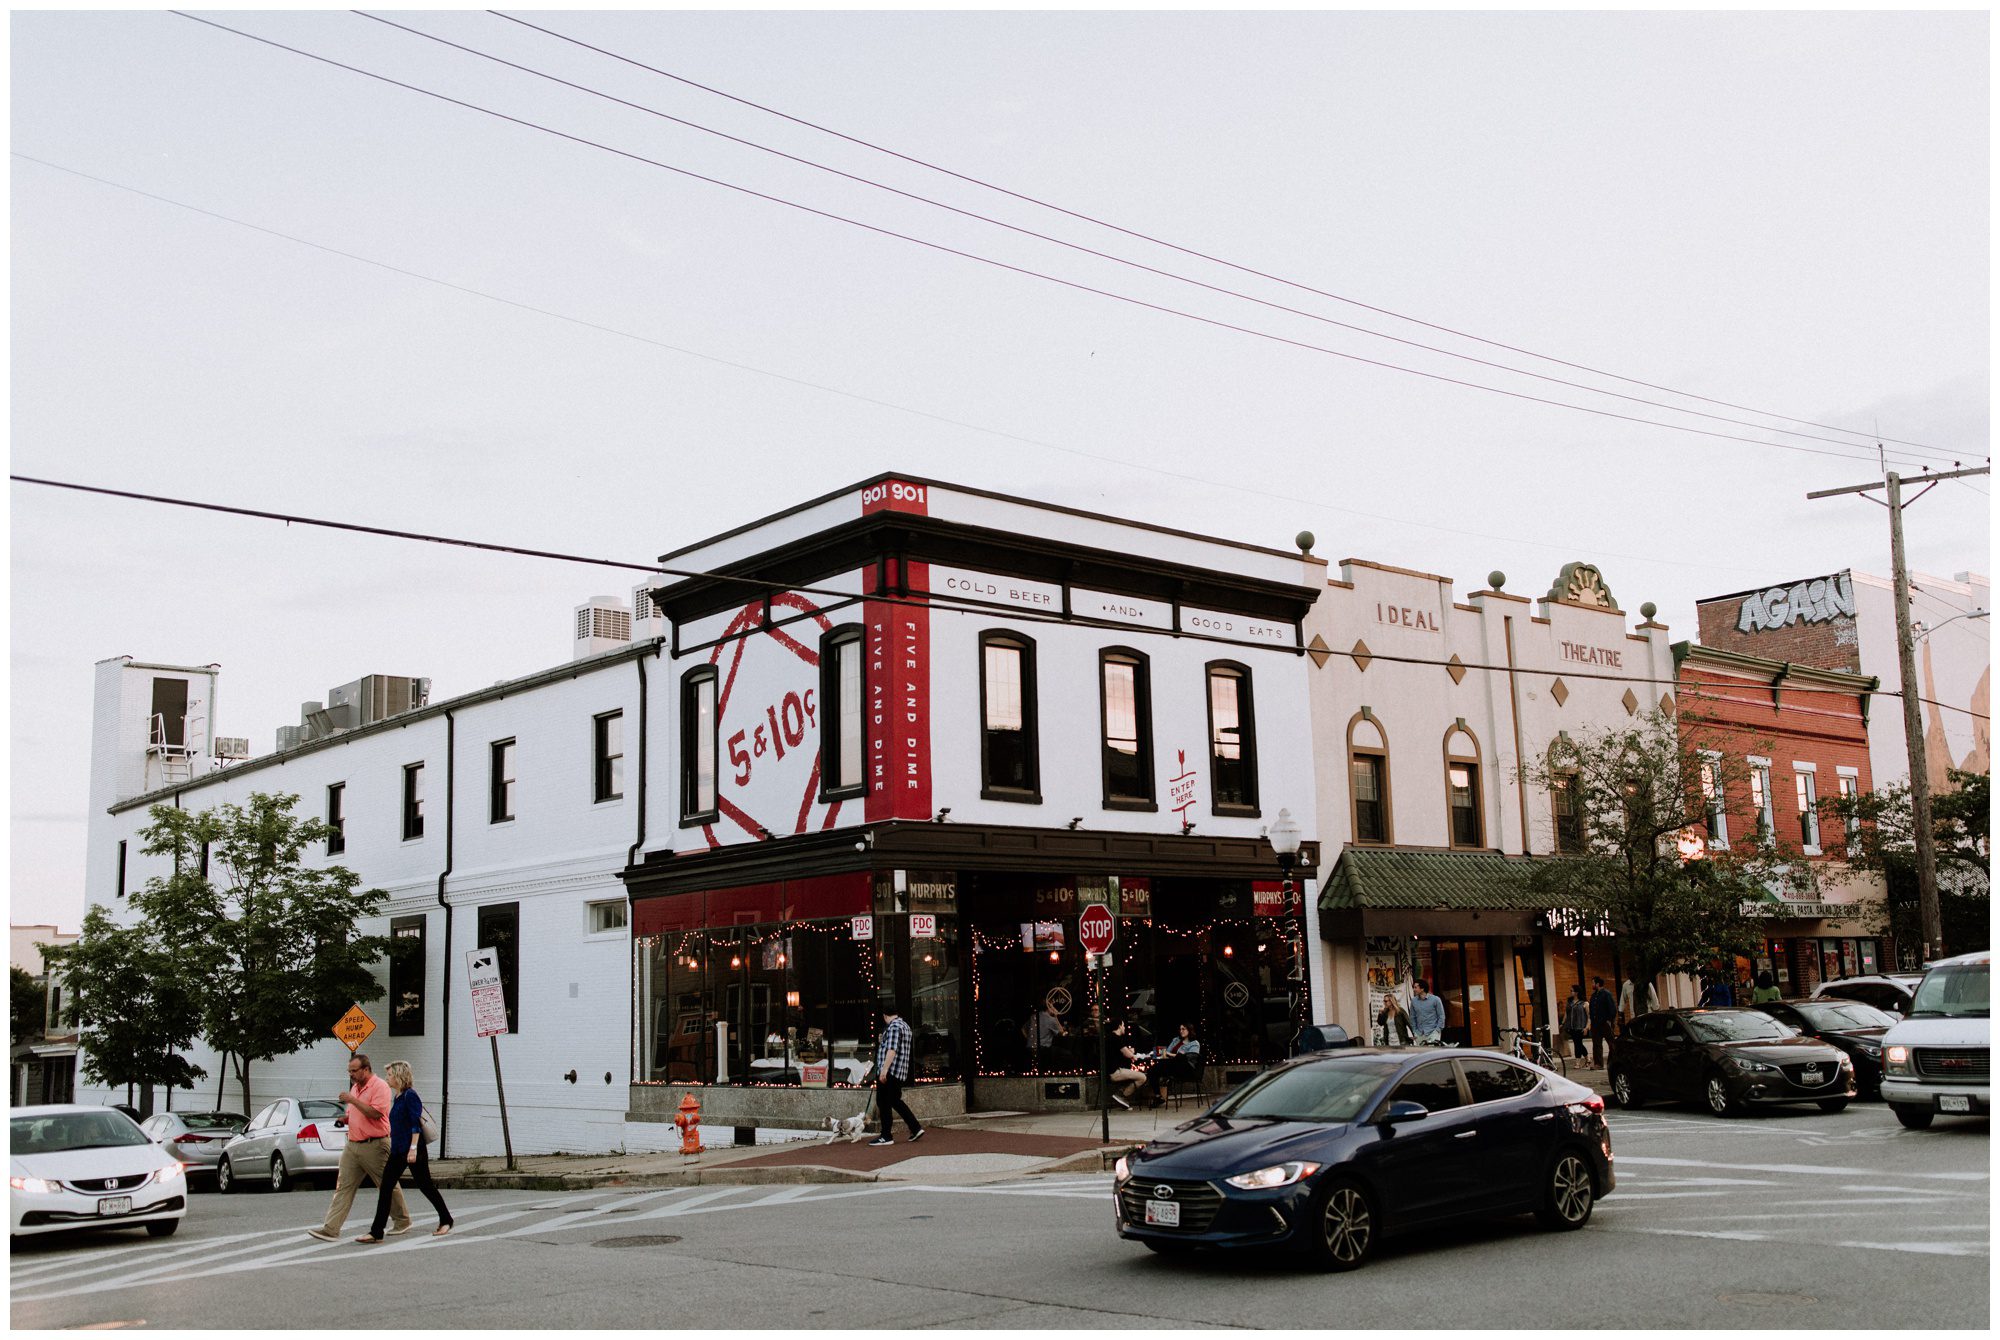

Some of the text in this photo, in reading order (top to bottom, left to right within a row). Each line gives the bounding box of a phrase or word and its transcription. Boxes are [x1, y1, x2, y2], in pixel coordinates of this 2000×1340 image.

[863, 484, 887, 505] 901
[891, 483, 924, 503] 901
[947, 577, 1051, 606] COLD BEER
[1377, 602, 1439, 631] IDEAL
[1191, 617, 1283, 639] GOOD EATS
[1560, 641, 1623, 668] THEATRE
[874, 623, 884, 791] FIVE AND DIME
[906, 622, 918, 789] FIVE AND DIME
[1170, 780, 1196, 797] ENTER
[1175, 790, 1193, 805] HERE
[876, 881, 892, 898] 901
[910, 882, 956, 899] MURPHY'S
[1253, 890, 1282, 905] MURPHY'S
[854, 919, 871, 932] FDC
[913, 917, 933, 928] FDC
[1082, 920, 1112, 939] STOP
[472, 979, 483, 987] OVER
[344, 1015, 365, 1024] SPEED
[345, 1024, 363, 1032] HUMP
[343, 1032, 365, 1040] AHEAD
